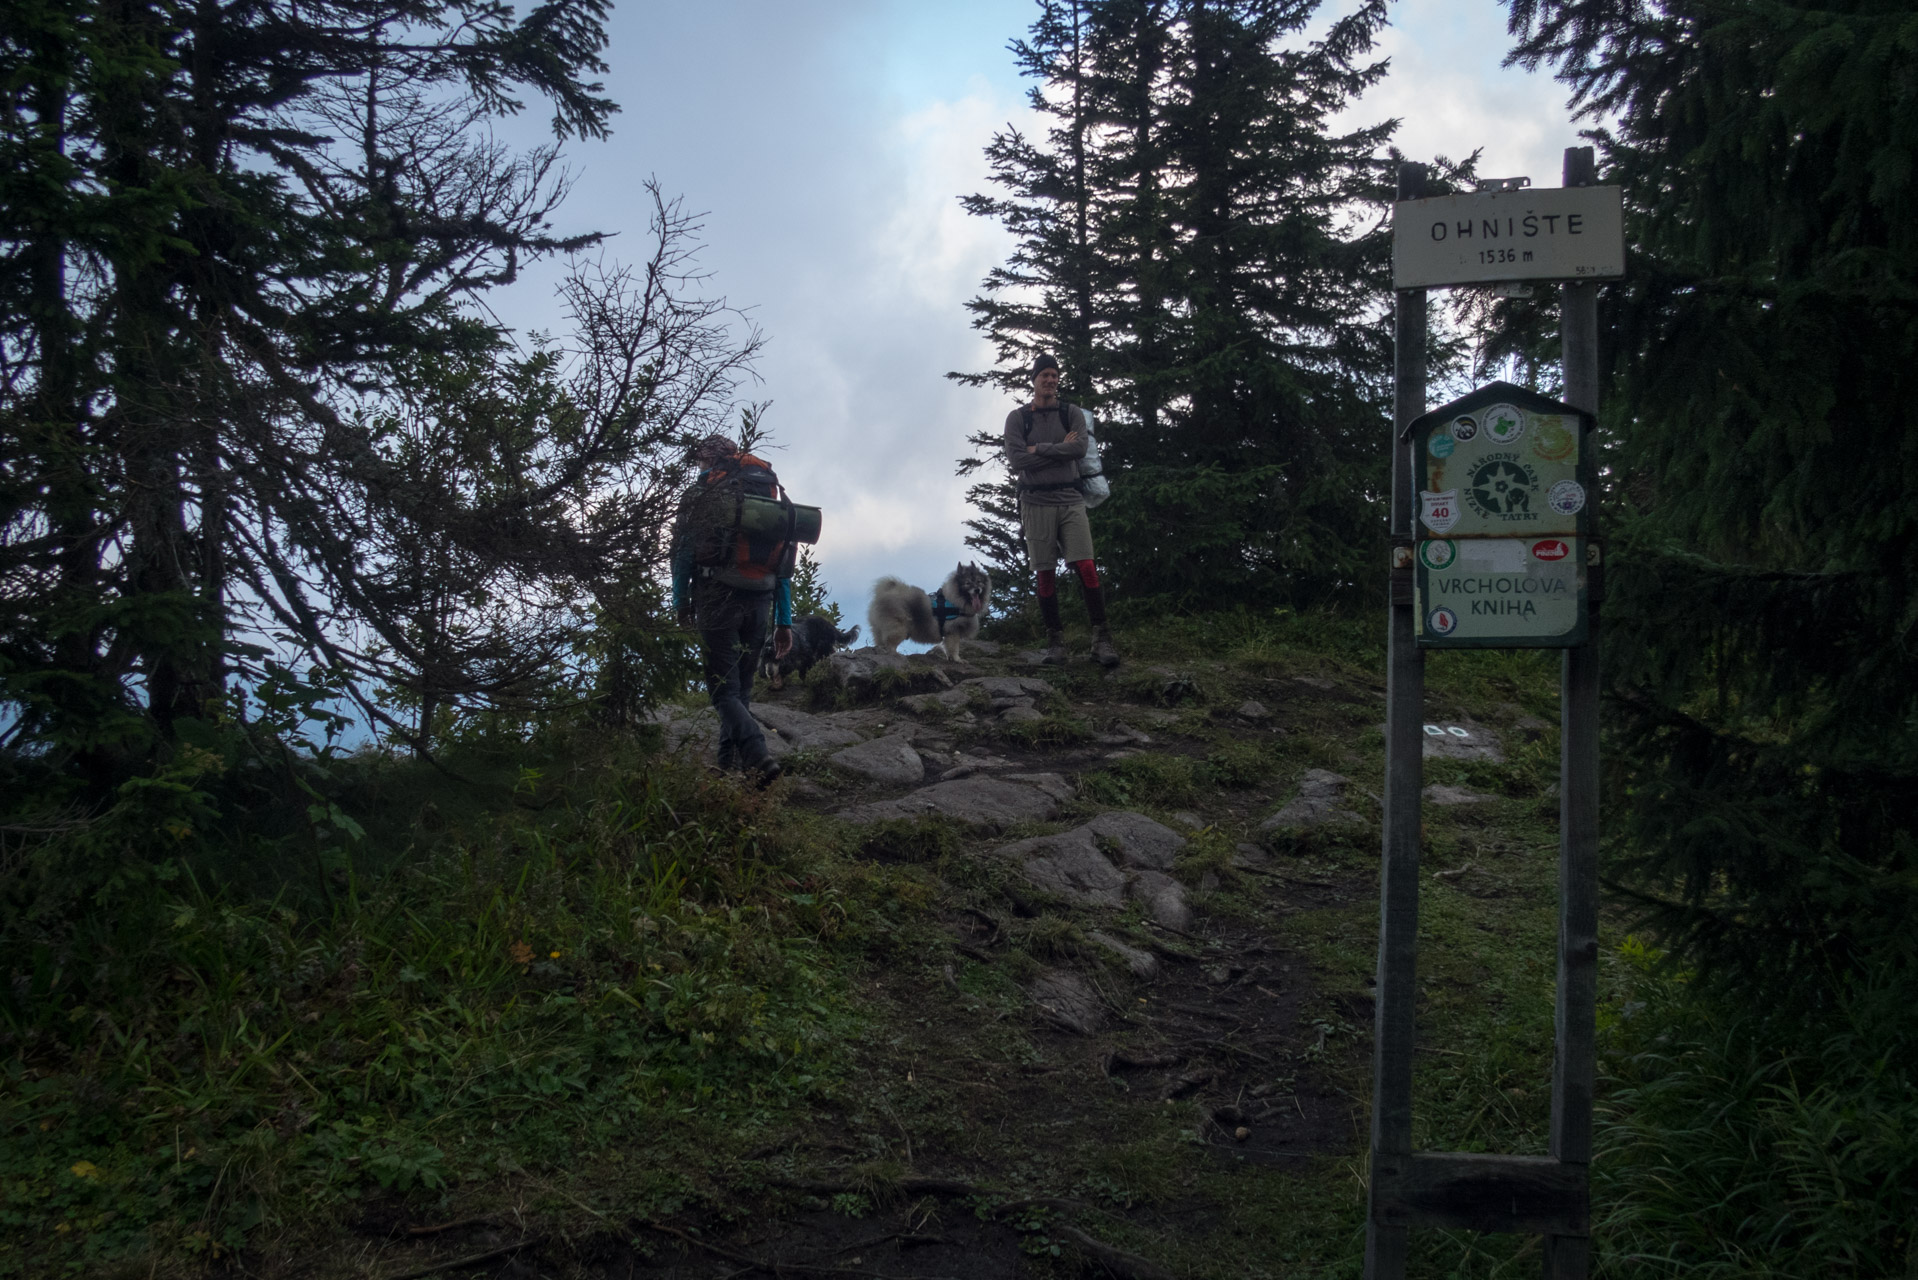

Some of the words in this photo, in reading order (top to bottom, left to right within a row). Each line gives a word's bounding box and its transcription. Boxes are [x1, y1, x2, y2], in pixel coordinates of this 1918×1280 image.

[1431, 209, 1583, 241] OHNIŠTE
[1480, 249, 1515, 264] 1536
[1523, 251, 1533, 262] m
[1432, 507, 1449, 518] 40
[1502, 513, 1538, 521] TATRY
[1471, 598, 1536, 615] KNIHA
